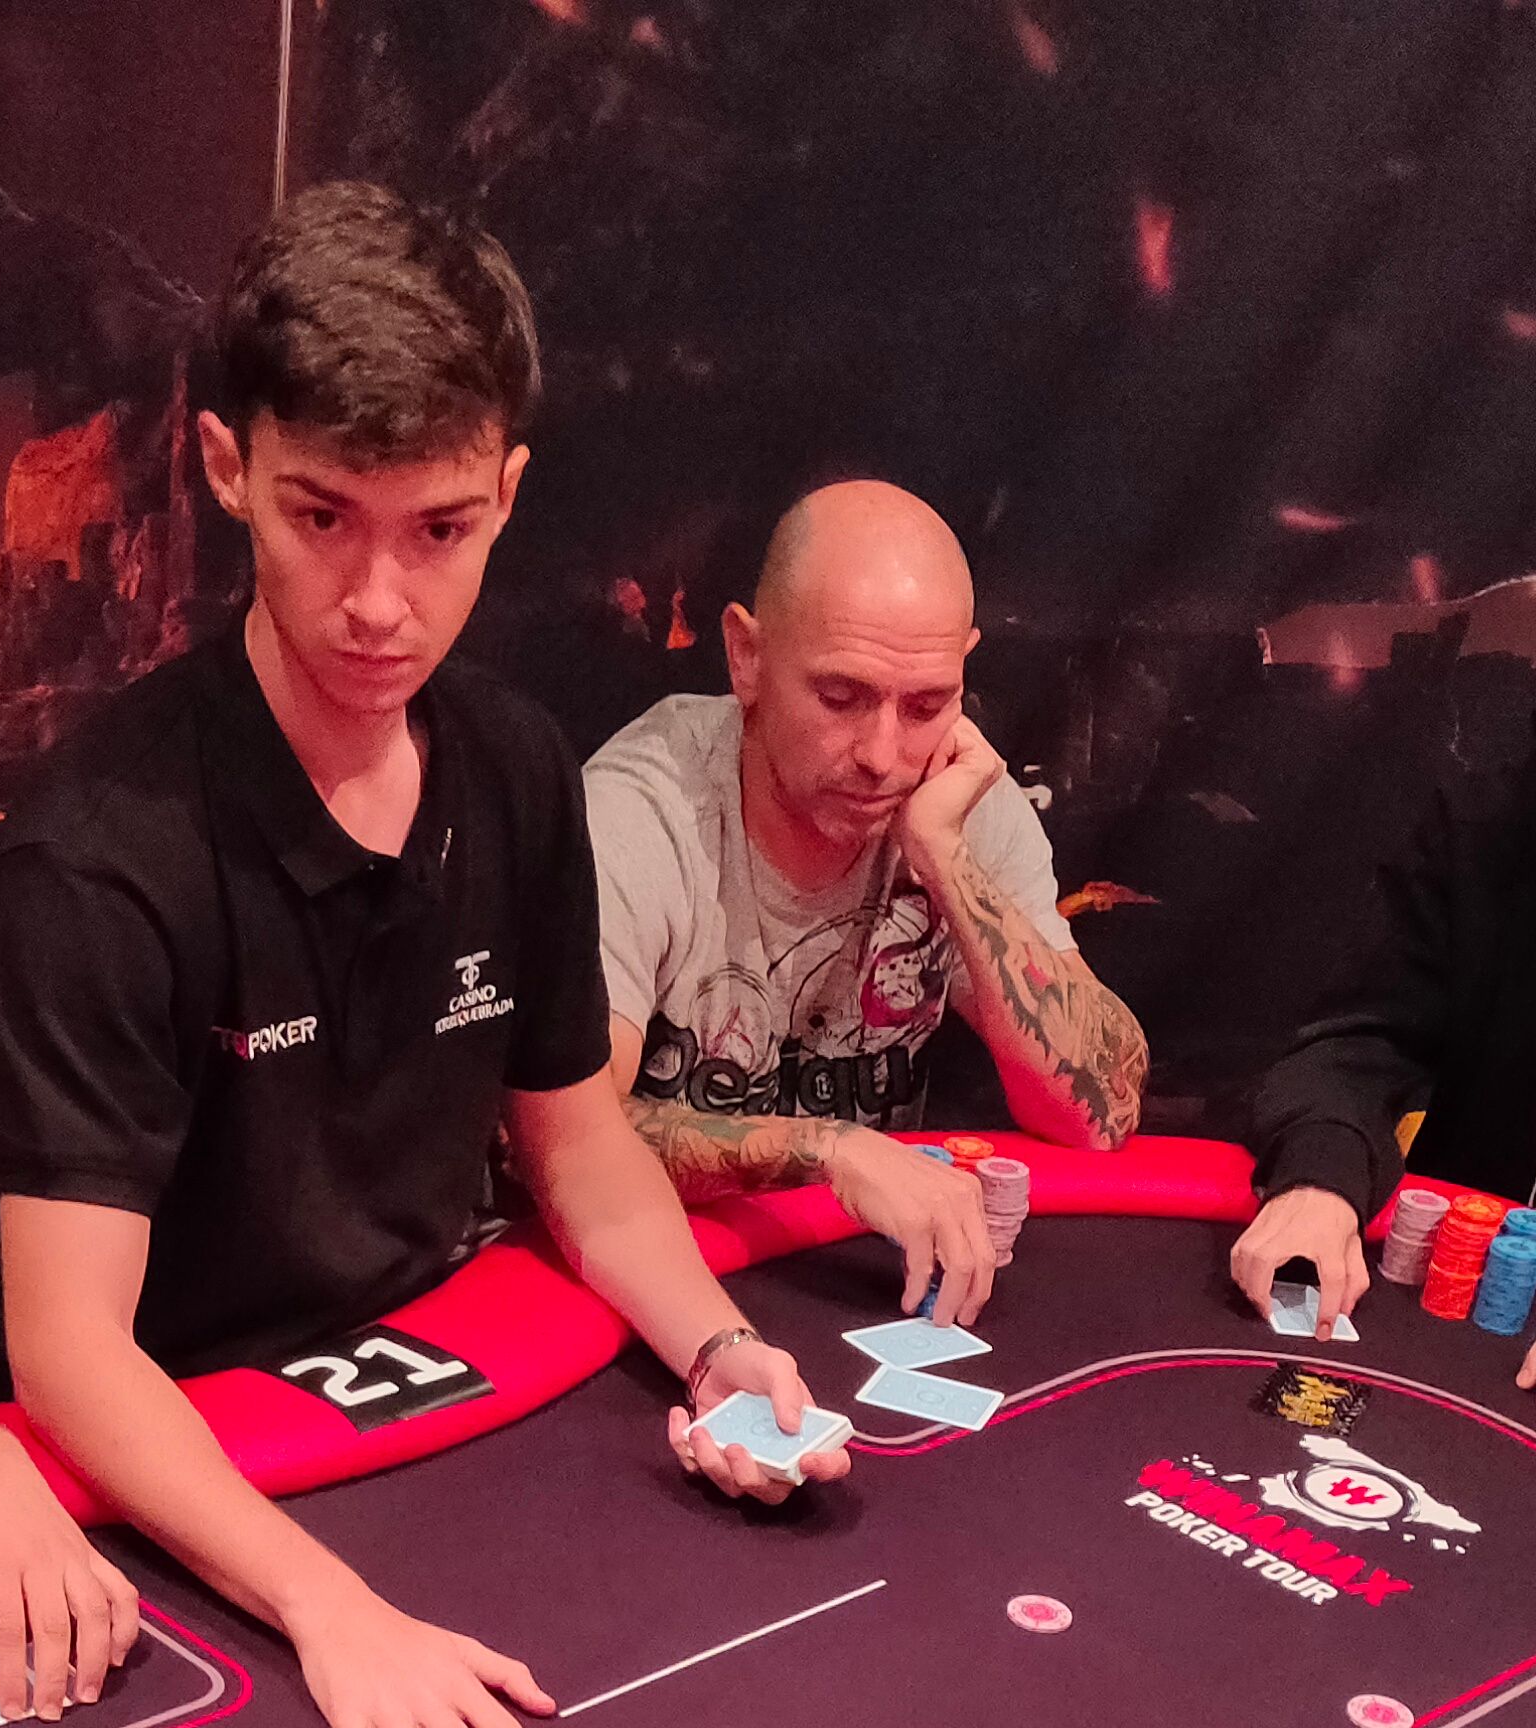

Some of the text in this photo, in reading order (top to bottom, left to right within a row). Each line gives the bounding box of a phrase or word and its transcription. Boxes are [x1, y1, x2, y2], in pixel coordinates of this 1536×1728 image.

[448, 983, 497, 1014] CASINO
[280, 1336, 469, 1408] 21
[1123, 1490, 1339, 1606] POKER TOUR
